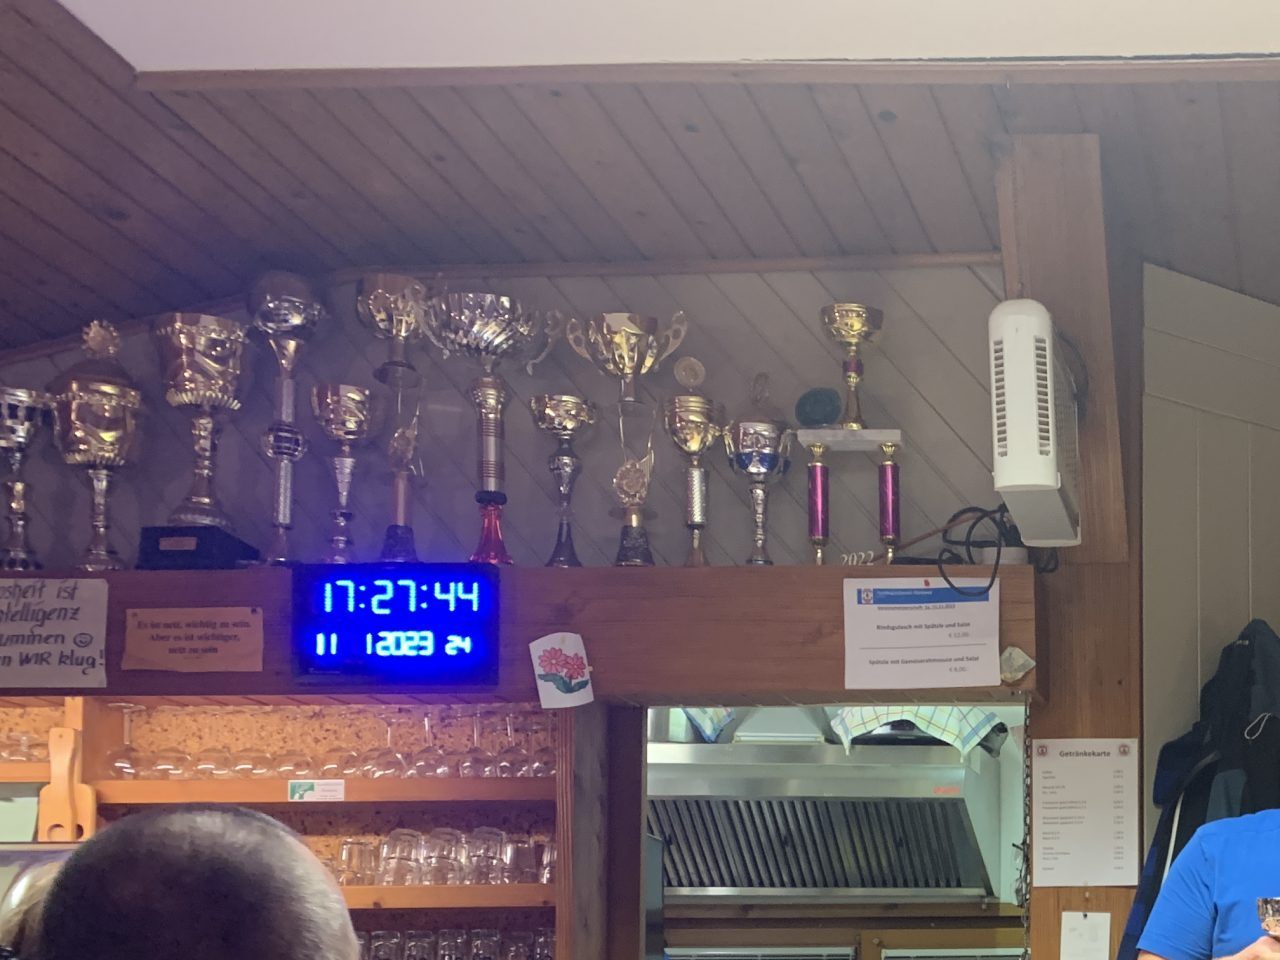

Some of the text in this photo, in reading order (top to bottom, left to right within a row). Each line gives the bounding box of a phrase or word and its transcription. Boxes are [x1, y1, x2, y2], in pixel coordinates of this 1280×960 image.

[840, 551, 874, 566] 2022
[56, 579, 79, 600] ist
[324, 579, 479, 615] 17:27:44
[0, 601, 80, 634] ntelligenz
[0, 633, 65, 646] ummen
[445, 635, 472, 655] 24
[19, 651, 52, 667] WIR
[58, 649, 104, 675] klug!
